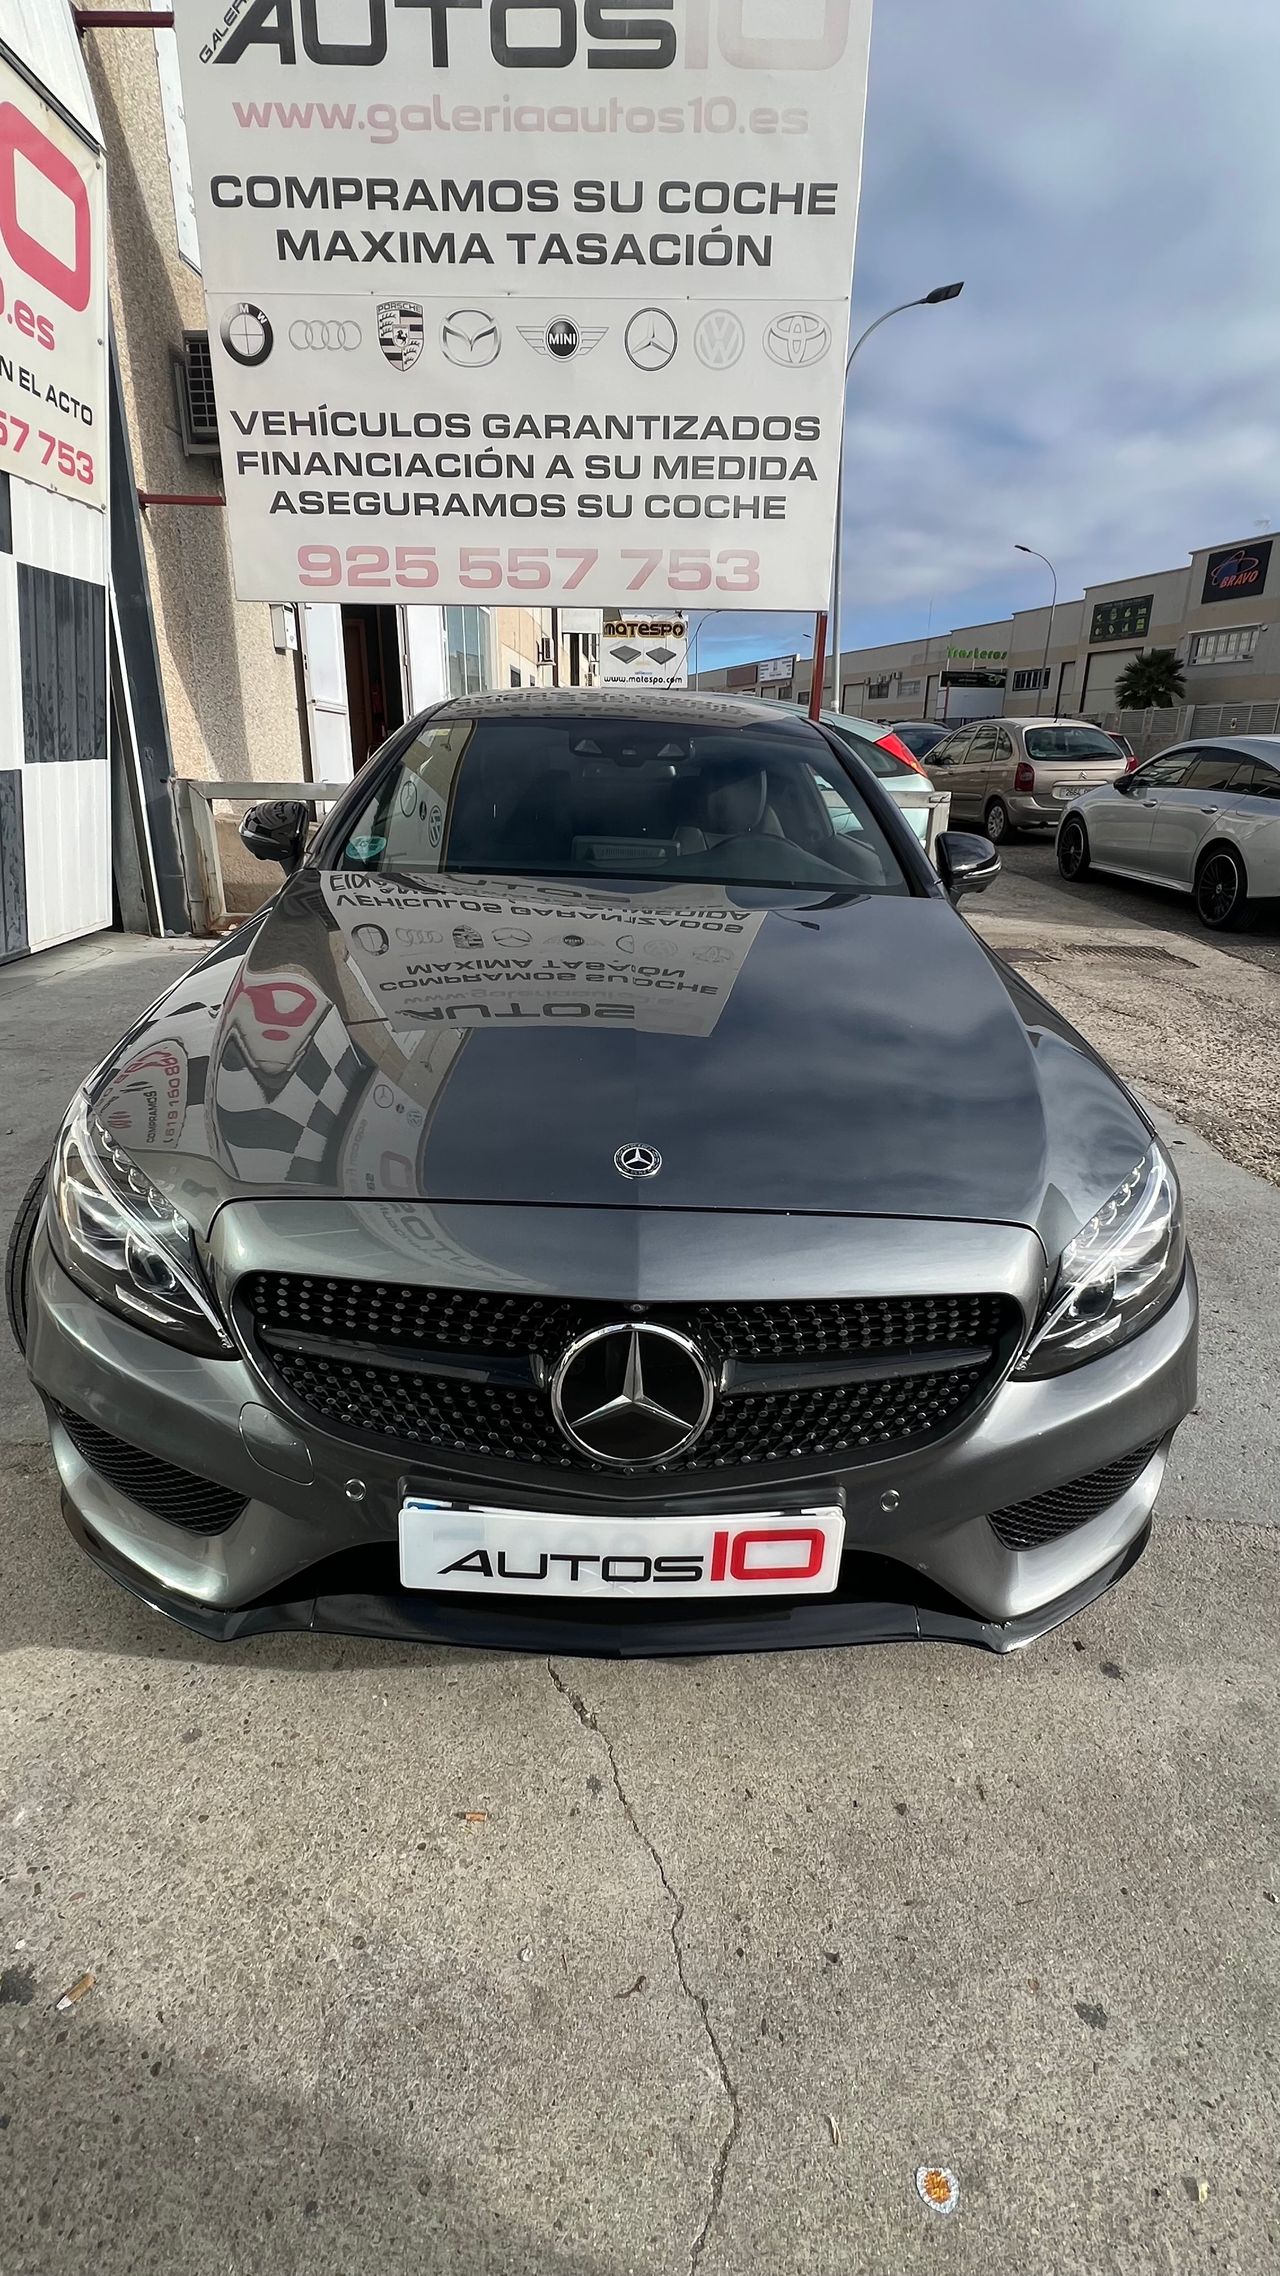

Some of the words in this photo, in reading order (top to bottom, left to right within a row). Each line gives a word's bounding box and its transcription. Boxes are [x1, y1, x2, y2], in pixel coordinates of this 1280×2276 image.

[232, 94, 808, 144] www.galeriaautos10.es
[211, 175, 558, 213] COMPRAMOS
[574, 180, 643, 213] SU
[659, 181, 838, 215] COCHE
[276, 229, 495, 264] MAXIMA
[506, 224, 771, 266] TASACIÓN
[377, 301, 424, 313] PORSCHE
[549, 332, 576, 345] MINI
[19, 366, 41, 398] EL
[45, 384, 93, 426] ACTO
[229, 403, 471, 438] VEHÍCULOS
[483, 413, 820, 441] GARANTIZADOS
[38, 429, 94, 486] 753
[237, 446, 534, 479] FINANCIACIÓN
[545, 454, 574, 479] A
[585, 455, 641, 480] SU
[653, 455, 818, 481] MEDIDA
[269, 490, 566, 518] ASEGURAMOS
[577, 494, 632, 519] SU
[645, 494, 787, 519] COCHE
[298, 544, 439, 588] 925
[459, 547, 598, 589] 557
[621, 548, 760, 591] 753
[1220, 570, 1258, 588] BRAVO
[947, 645, 1007, 660] Trasteros
[604, 676, 683, 685] www.matespo.com
[436, 1528, 826, 1582] AUTOS10
